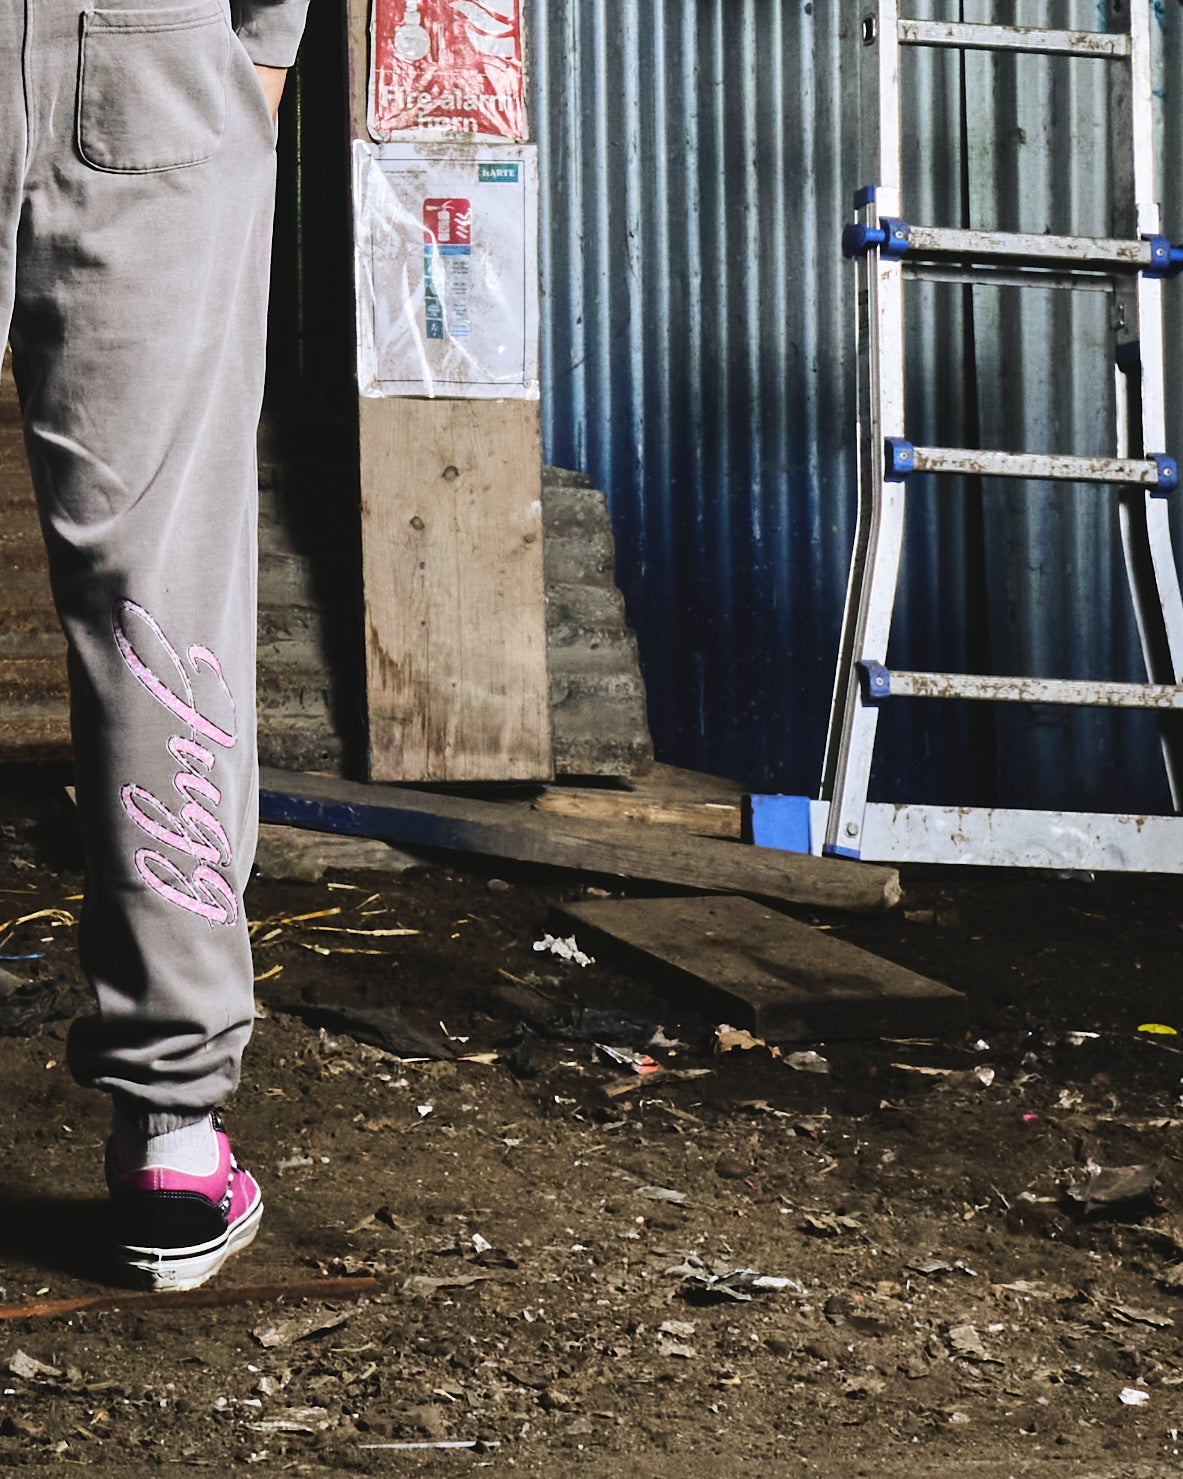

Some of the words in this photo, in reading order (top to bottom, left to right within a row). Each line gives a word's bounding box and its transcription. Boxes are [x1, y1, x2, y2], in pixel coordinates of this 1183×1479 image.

[383, 85, 432, 108] Fire
[439, 89, 513, 111] alarm
[418, 112, 478, 133] horn
